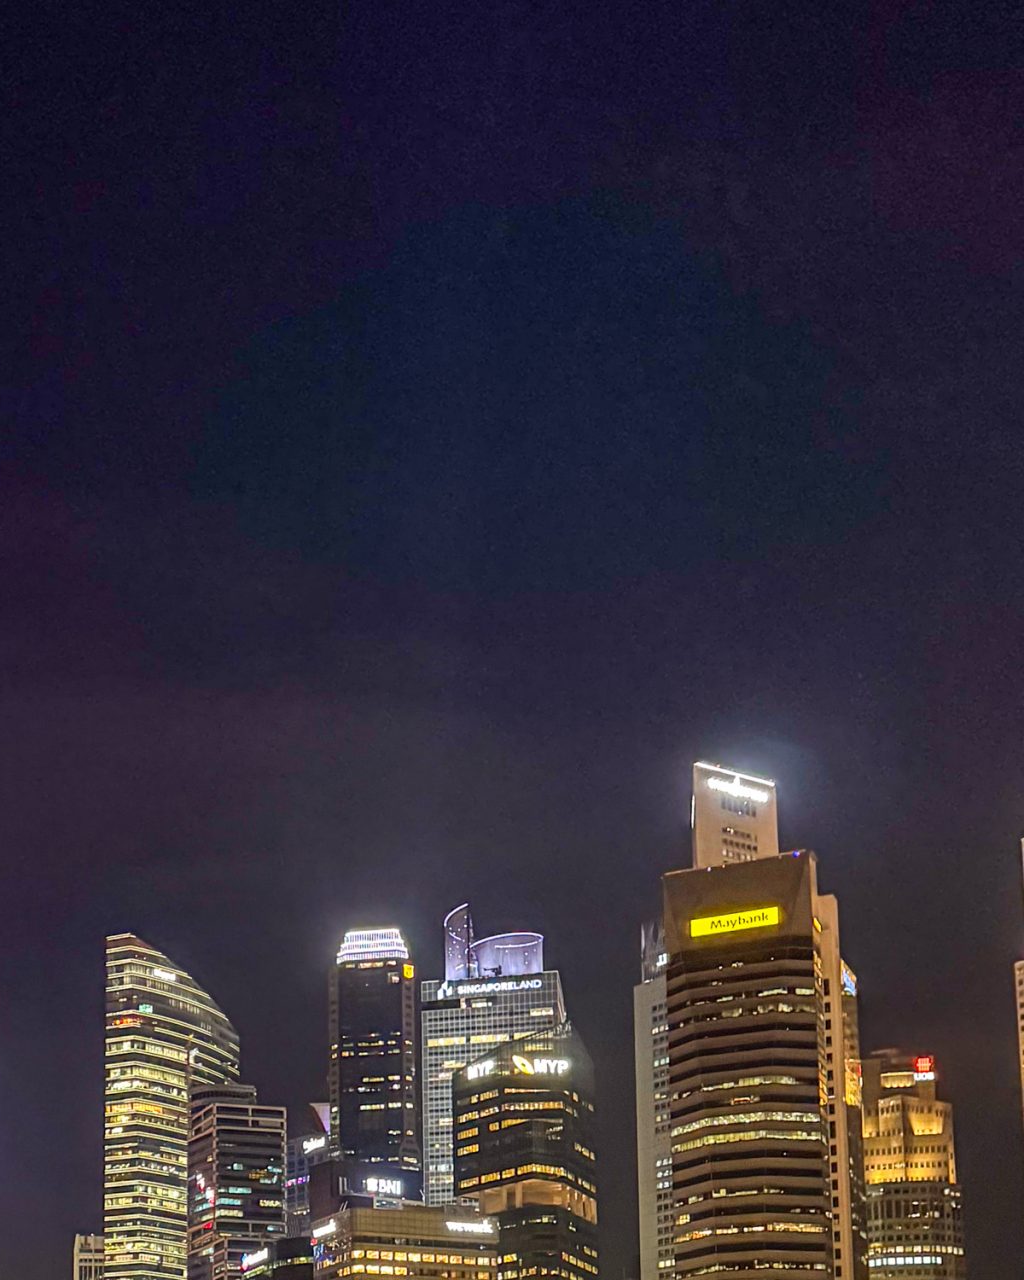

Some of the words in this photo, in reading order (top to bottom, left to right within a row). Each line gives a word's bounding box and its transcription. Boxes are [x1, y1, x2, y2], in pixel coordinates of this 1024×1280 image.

[710, 912, 769, 930] Maybank
[467, 1060, 494, 1080] MYP
[534, 1058, 569, 1074] MYP
[378, 1179, 401, 1195] BNI
